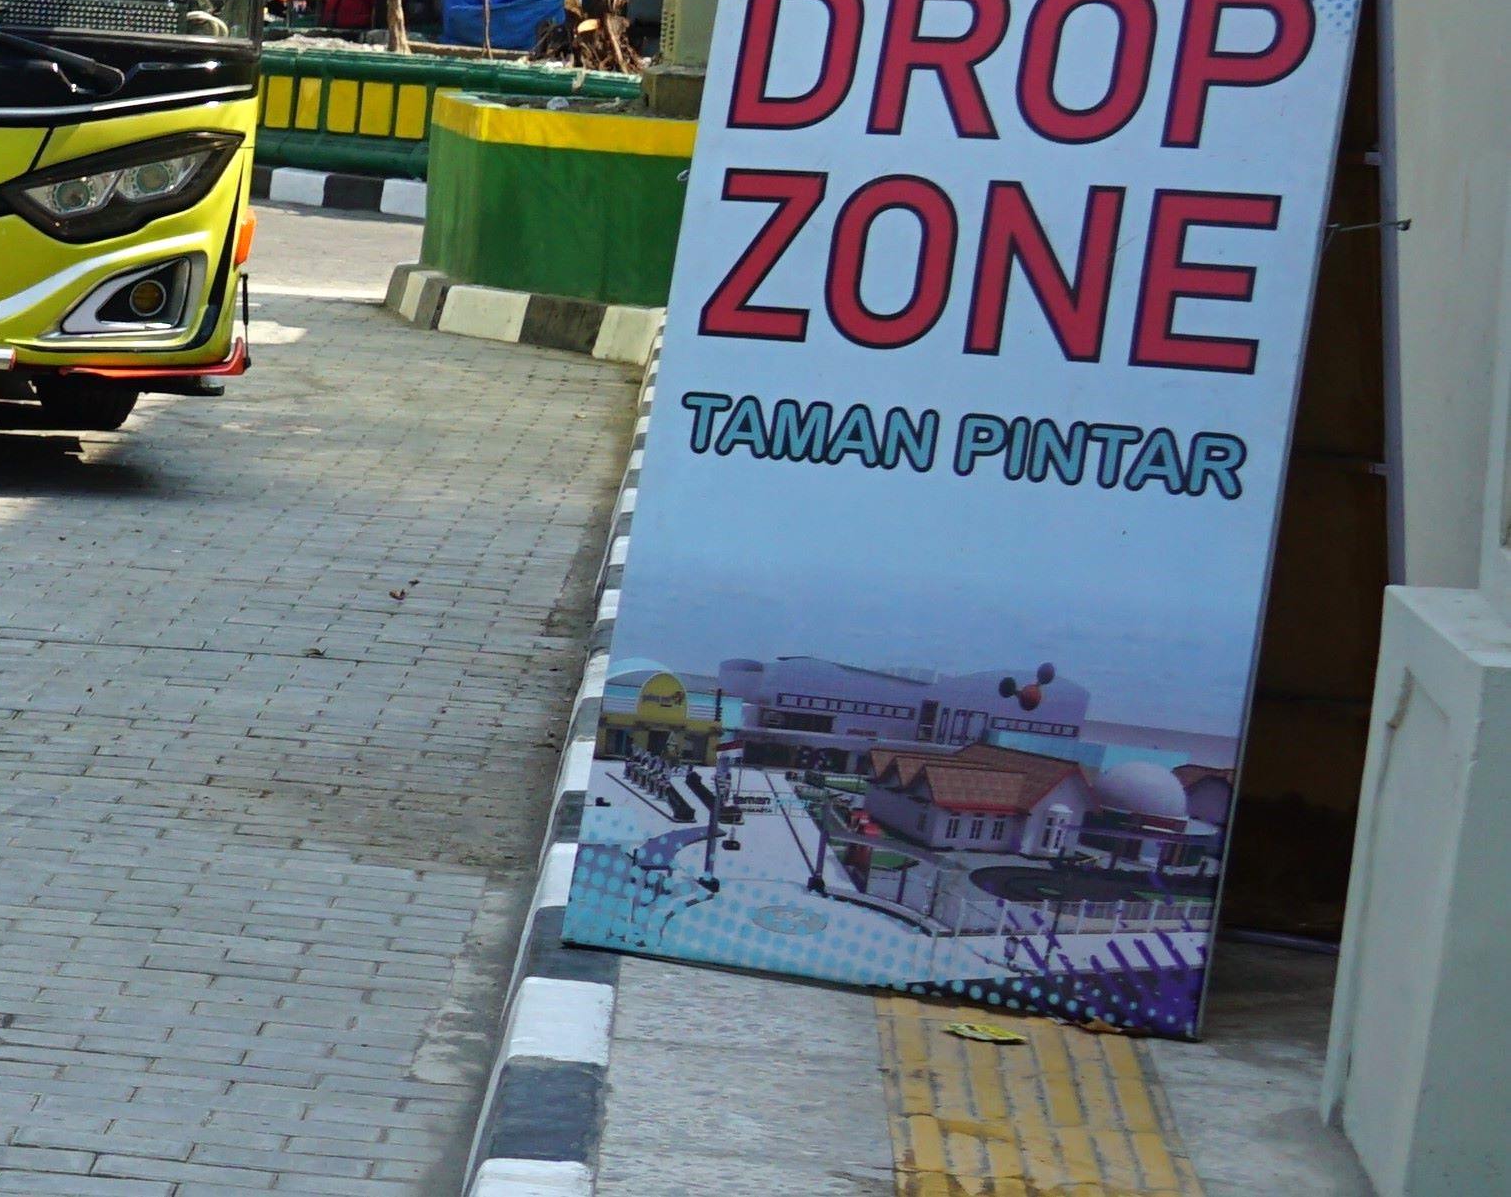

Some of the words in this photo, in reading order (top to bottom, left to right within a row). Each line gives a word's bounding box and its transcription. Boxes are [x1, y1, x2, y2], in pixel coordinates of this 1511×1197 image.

[697, 168, 1282, 375] ZONE
[681, 391, 939, 473] TAMAN
[953, 412, 1247, 501] PINTAR
